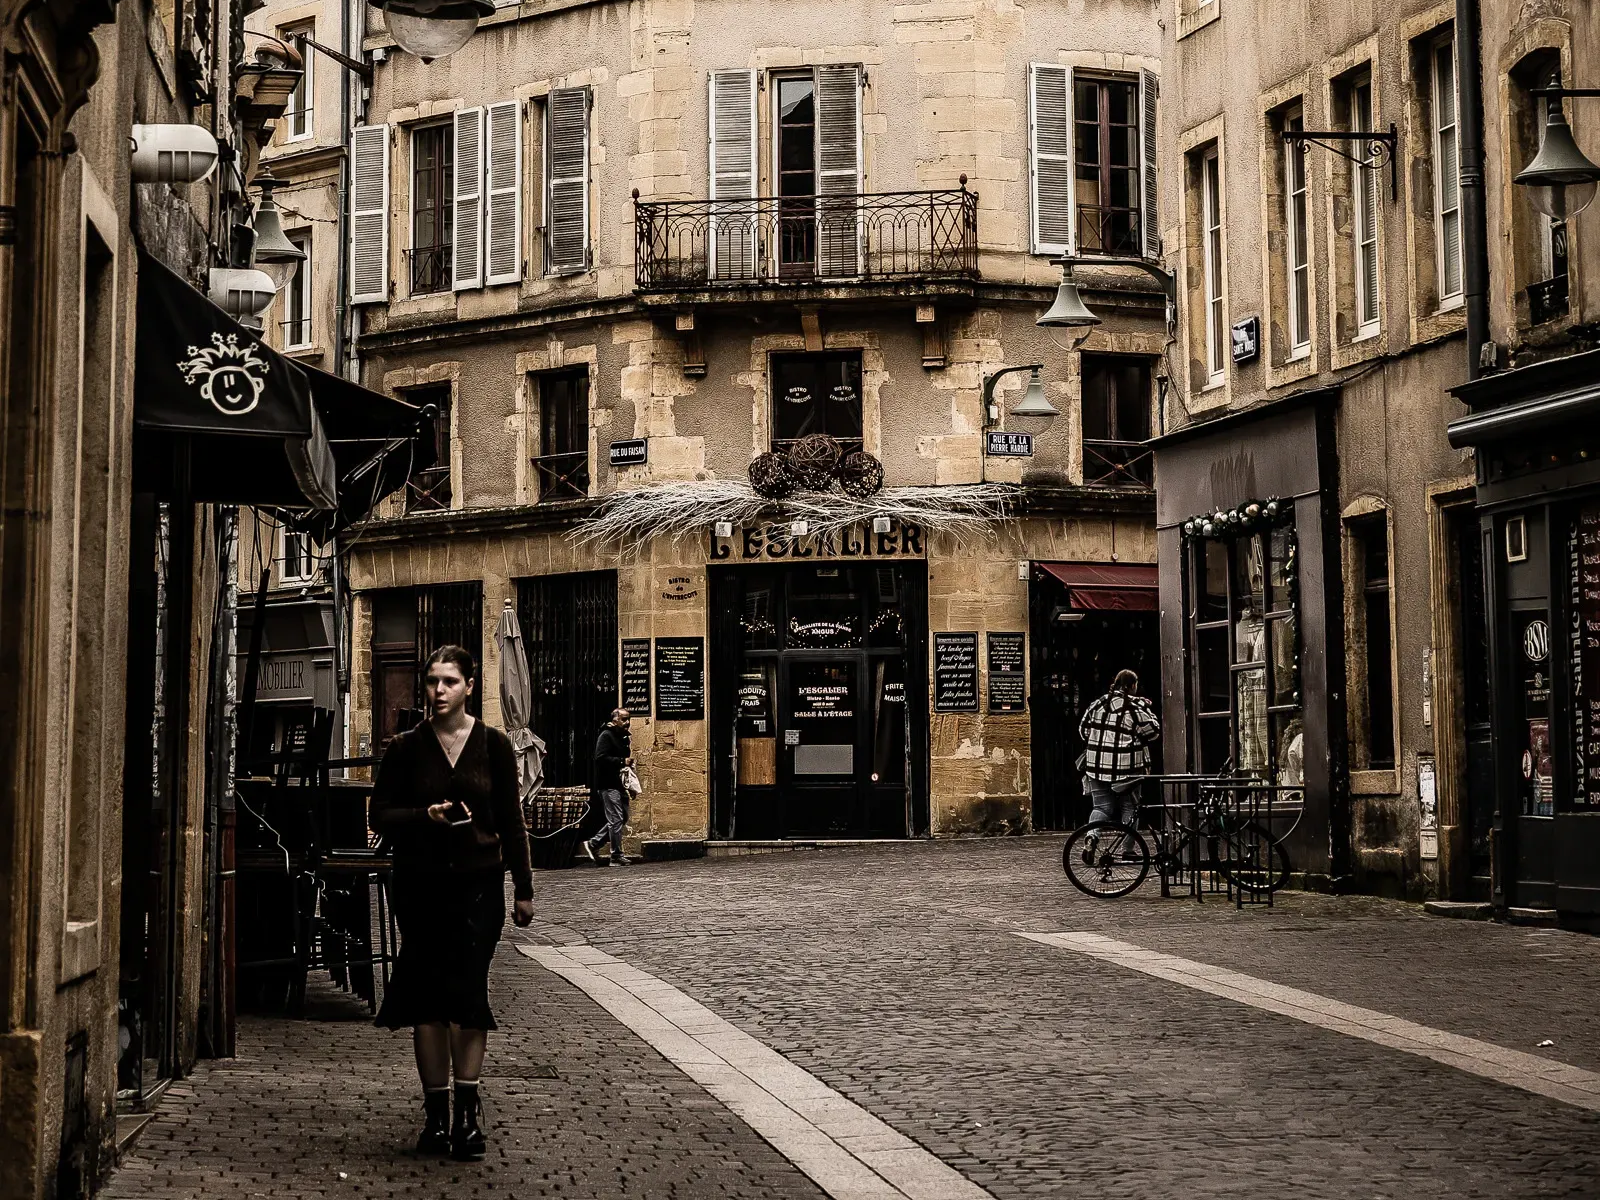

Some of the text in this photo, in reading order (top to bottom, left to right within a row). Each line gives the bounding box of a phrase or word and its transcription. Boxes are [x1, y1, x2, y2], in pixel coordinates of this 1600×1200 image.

[993, 435, 1027, 444] RUE DE LA
[610, 446, 644, 457] RUE DU FAISAN
[991, 444, 1028, 453] PIERRE HARDIE
[1571, 610, 1583, 696] sainte
[256, 660, 304, 690] MOBILIER
[738, 688, 766, 696] RODUITS
[884, 694, 905, 702] MAISO
[1573, 702, 1585, 804] bazaar
